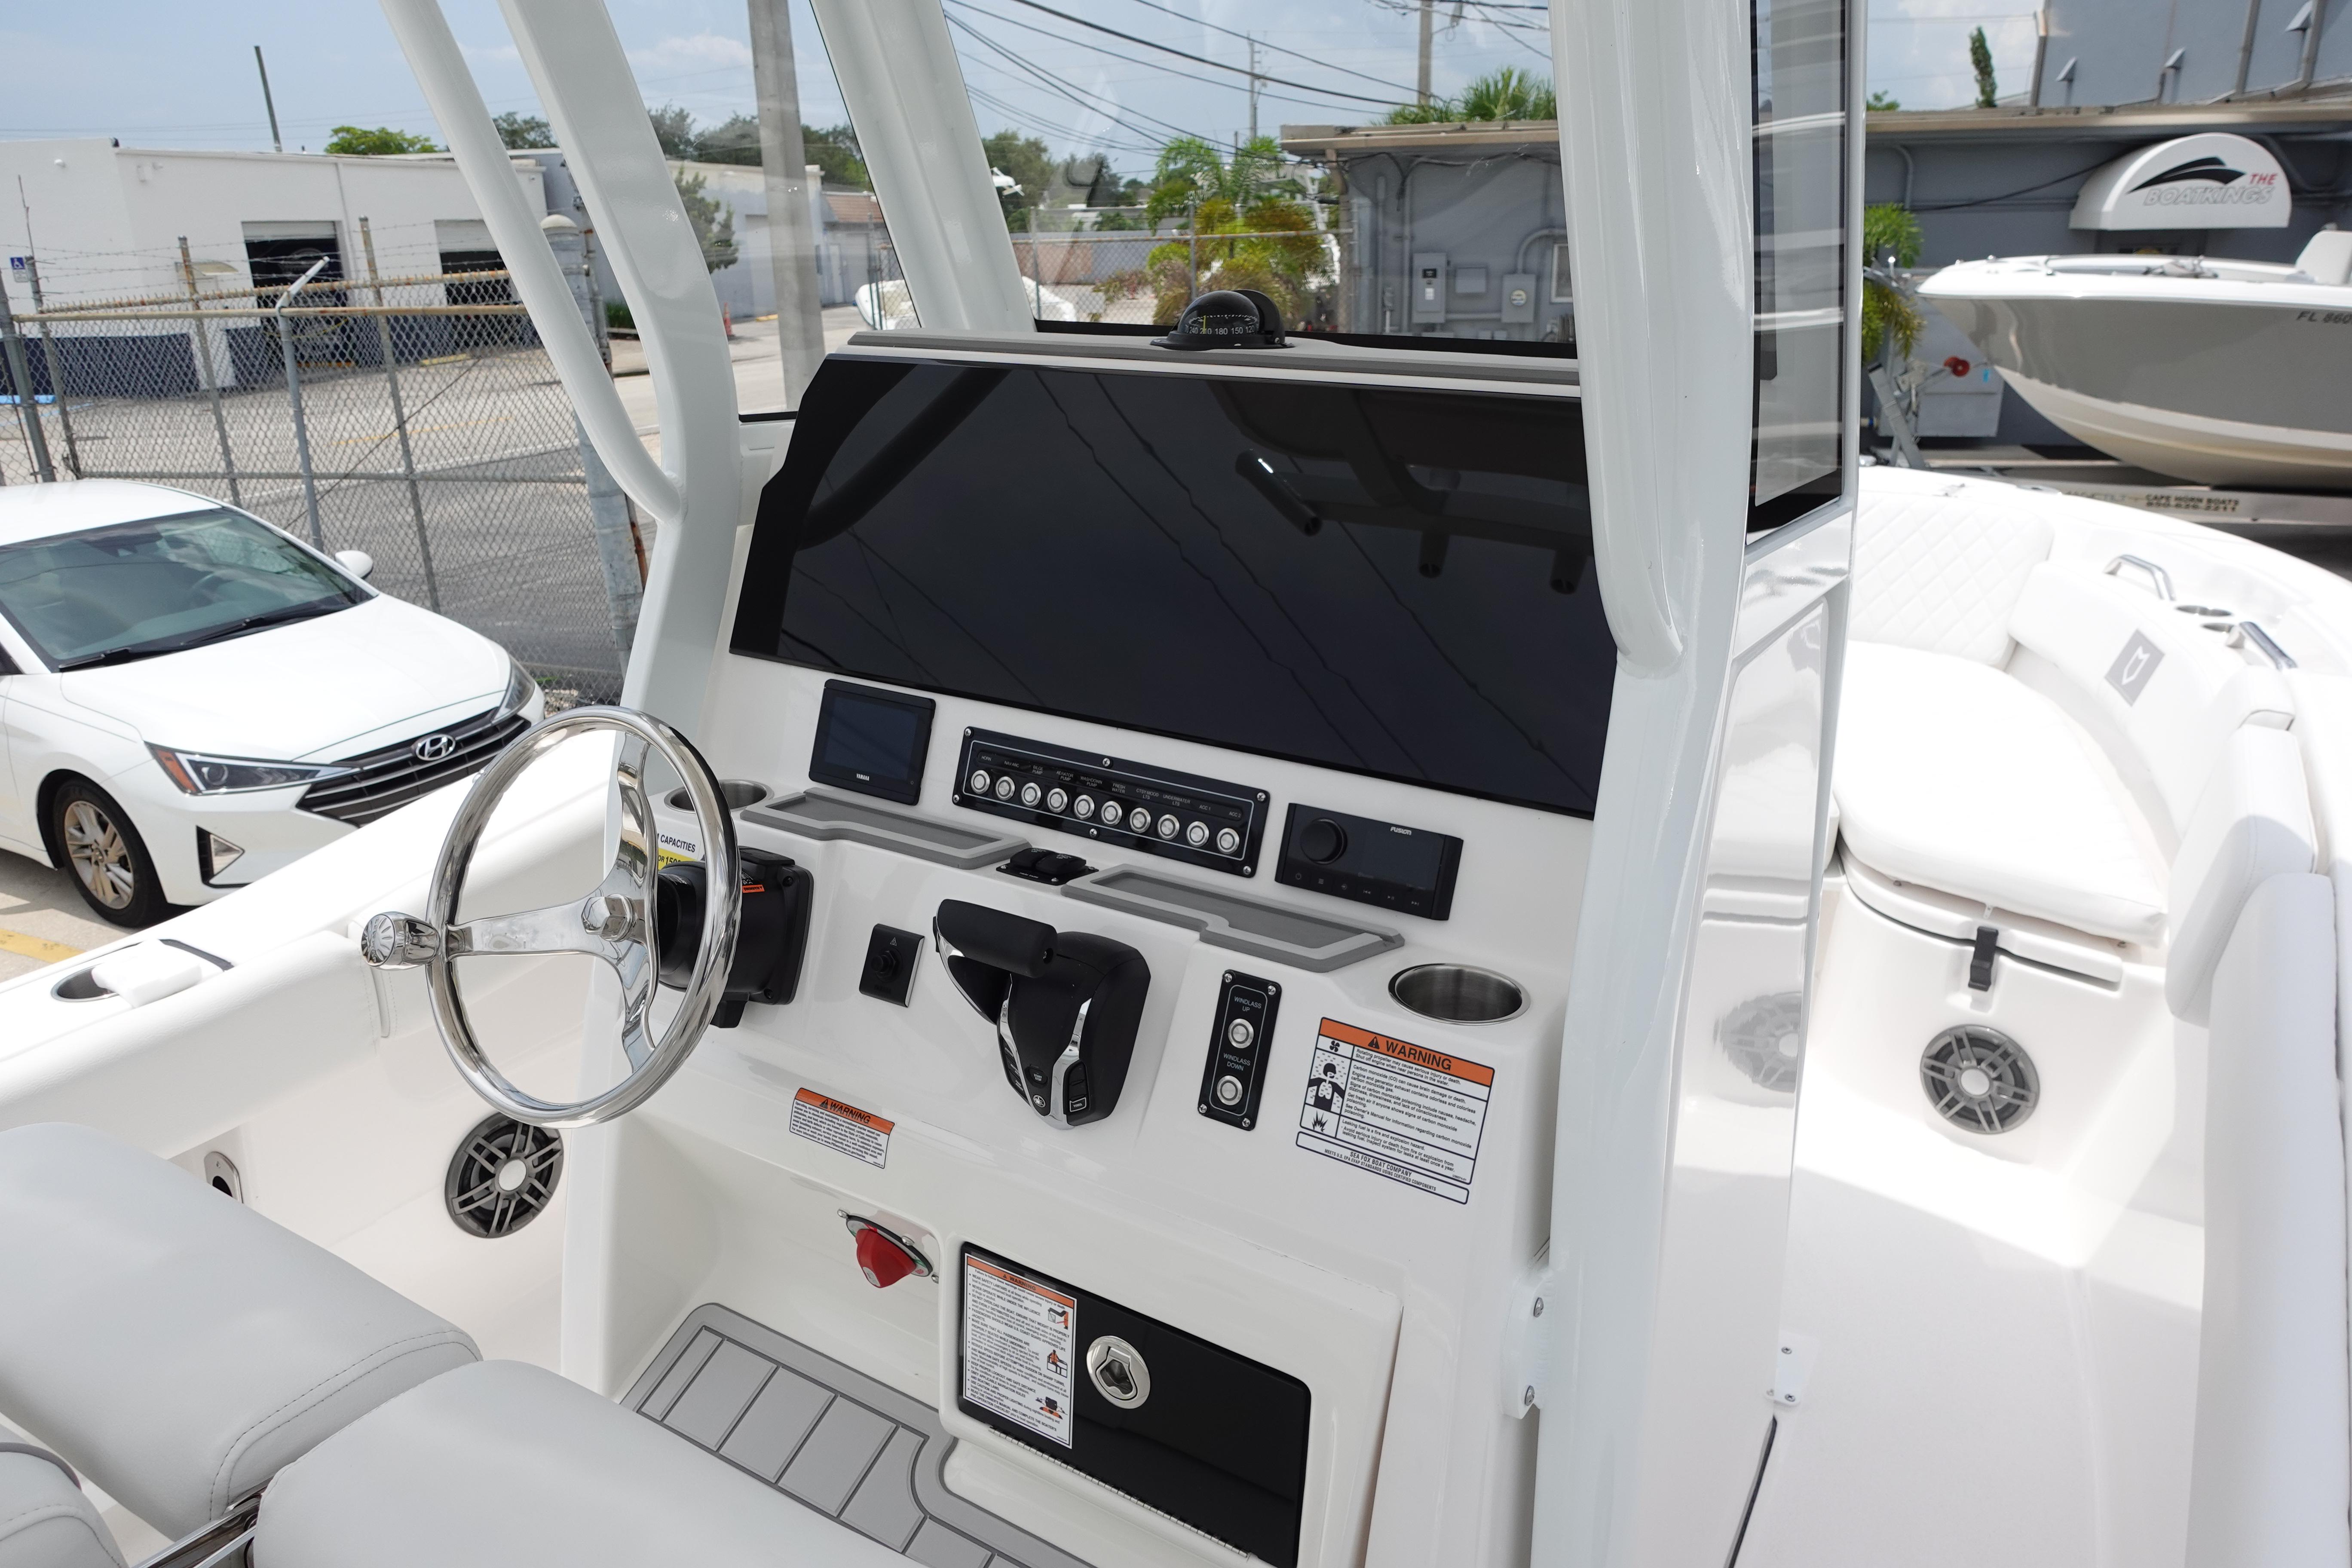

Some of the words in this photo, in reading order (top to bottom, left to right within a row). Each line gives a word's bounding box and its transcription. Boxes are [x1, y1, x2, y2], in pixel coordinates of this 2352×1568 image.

[2250, 173, 2277, 185] THE
[2143, 186, 2275, 206] BOATKINGS
[2296, 311, 2317, 322] FL
[1080, 776, 1102, 784] WASHDOWN
[1163, 794, 1191, 804] UNDERWATER
[661, 834, 695, 853] CAPACITIES
[1234, 996, 1262, 1009] WINDLASS
[1223, 1053, 1251, 1066] WINDLASS
[1227, 1061, 1244, 1071] DOWN
[1356, 1048, 1373, 1059] Rotating
[1373, 1054, 1392, 1064] propeller
[1414, 1066, 1430, 1075] serious
[1430, 1071, 1442, 1080] injury
[1448, 1076, 1461, 1084] death.
[1386, 1040, 1452, 1071] WARNING
[1351, 1075, 1365, 1083] carbon
[1365, 1080, 1385, 1090] monoxide
[1353, 1064, 1368, 1073] Carbon
[1368, 1069, 1388, 1079] monoxide
[1387, 1075, 1398, 1083] (CO)
[1430, 1088, 1447, 1099] damage
[1453, 1095, 1467, 1103] death.
[1371, 1058, 1385, 1067] engine
[1406, 1070, 1424, 1079] persons
[1436, 1078, 1449, 1086] water.
[1346, 1097, 1367, 1109] poisoning.
[1348, 1086, 1369, 1097] dizziness,
[1368, 1092, 1393, 1105] drowsiness,
[1415, 1107, 1448, 1121] consciousness.
[1349, 1081, 1361, 1090] Signs
[1366, 1086, 1381, 1095] carbon
[1381, 1091, 1401, 1101] monoxide
[1401, 1097, 1422, 1109] poisoning
[1422, 1104, 1438, 1113] include
[1437, 1110, 1455, 1119] nausea,
[1454, 1114, 1477, 1127] headache,
[1351, 1071, 1366, 1080] Engine
[1374, 1078, 1394, 1089] generator
[1394, 1084, 1411, 1093] exhaust
[1410, 1089, 1429, 1099] contains
[1429, 1095, 1447, 1105] odorless
[1456, 1103, 1476, 1114] colorless
[830, 1101, 871, 1124] WARNING
[1344, 1108, 1365, 1119] poisoning.
[1375, 1102, 1390, 1111] anyone
[1390, 1106, 1404, 1115] shows
[1404, 1111, 1416, 1119] signs
[1421, 1116, 1436, 1125] carbon
[1436, 1121, 1458, 1132] monoxide
[1341, 1118, 1358, 1129] Leaking
[1389, 1135, 1410, 1146] explosion
[1410, 1141, 1425, 1151] hazard.
[1353, 1106, 1370, 1115] Owner's
[1370, 1111, 1385, 1120] Manual
[1391, 1118, 1415, 1130] information
[1415, 1126, 1435, 1138] regarding
[1435, 1133, 1451, 1142] carbon
[1451, 1137, 1472, 1148] monoxide
[1341, 1130, 1357, 1139] leaking
[1366, 1138, 1381, 1148] Inspect
[1381, 1143, 1396, 1153] system
[1355, 1130, 1370, 1139] serious
[1370, 1135, 1383, 1143] injury
[1423, 1152, 1443, 1164] explosion
[1324, 1148, 1336, 1157] MEETS
[1360, 1161, 1382, 1173] STANDARDS
[1381, 1168, 1393, 1176] USING
[1393, 1172, 1412, 1183] CERTIFIED
[1411, 1179, 1436, 1191] COMPONENTS
[1349, 1151, 1360, 1160] SEA
[1360, 1155, 1371, 1164] FOX
[1371, 1158, 1385, 1168] BOAT
[1386, 1163, 1412, 1178] COMPANY
[1010, 1276, 1036, 1291] WARNING
